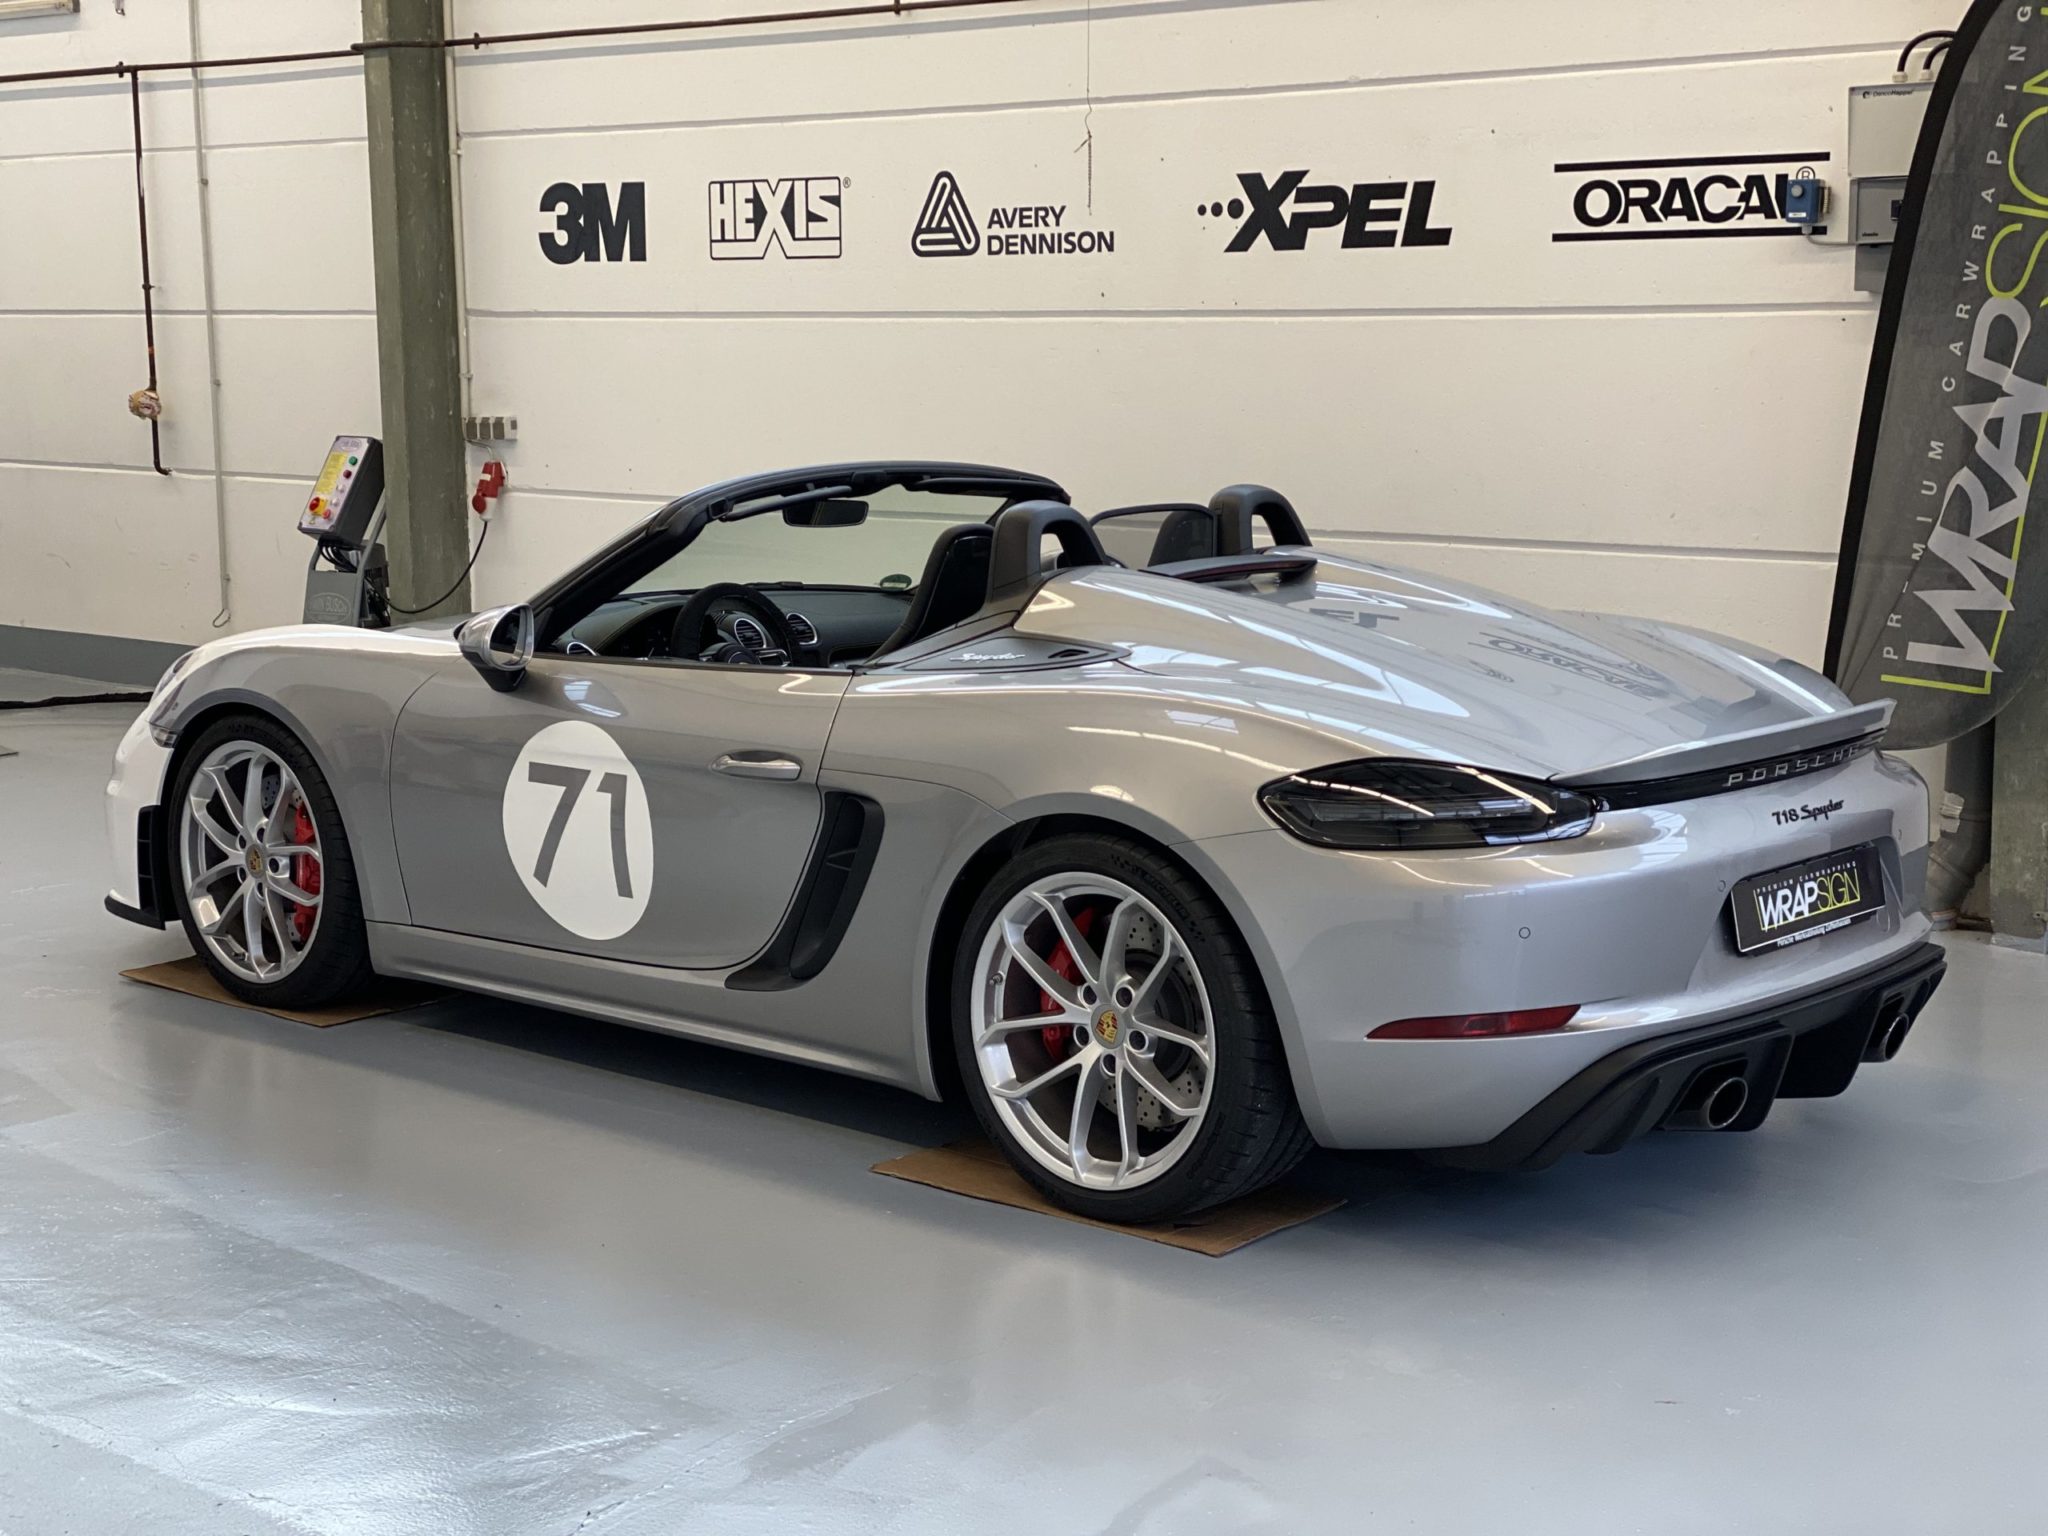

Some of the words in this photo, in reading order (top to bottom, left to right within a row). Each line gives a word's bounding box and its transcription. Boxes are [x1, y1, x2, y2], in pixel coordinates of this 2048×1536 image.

[539, 181, 647, 265] 3M
[709, 176, 842, 260] HEXIS
[987, 205, 1067, 230] AVERY
[1223, 169, 1453, 253] XPEL
[987, 230, 1115, 256] DENNISON
[1725, 746, 1859, 787] PORSCHE
[528, 761, 634, 899] 71
[1772, 808, 1799, 826] 718
[1800, 799, 1844, 822] Spyder
[1757, 879, 1794, 895] PREMIUM
